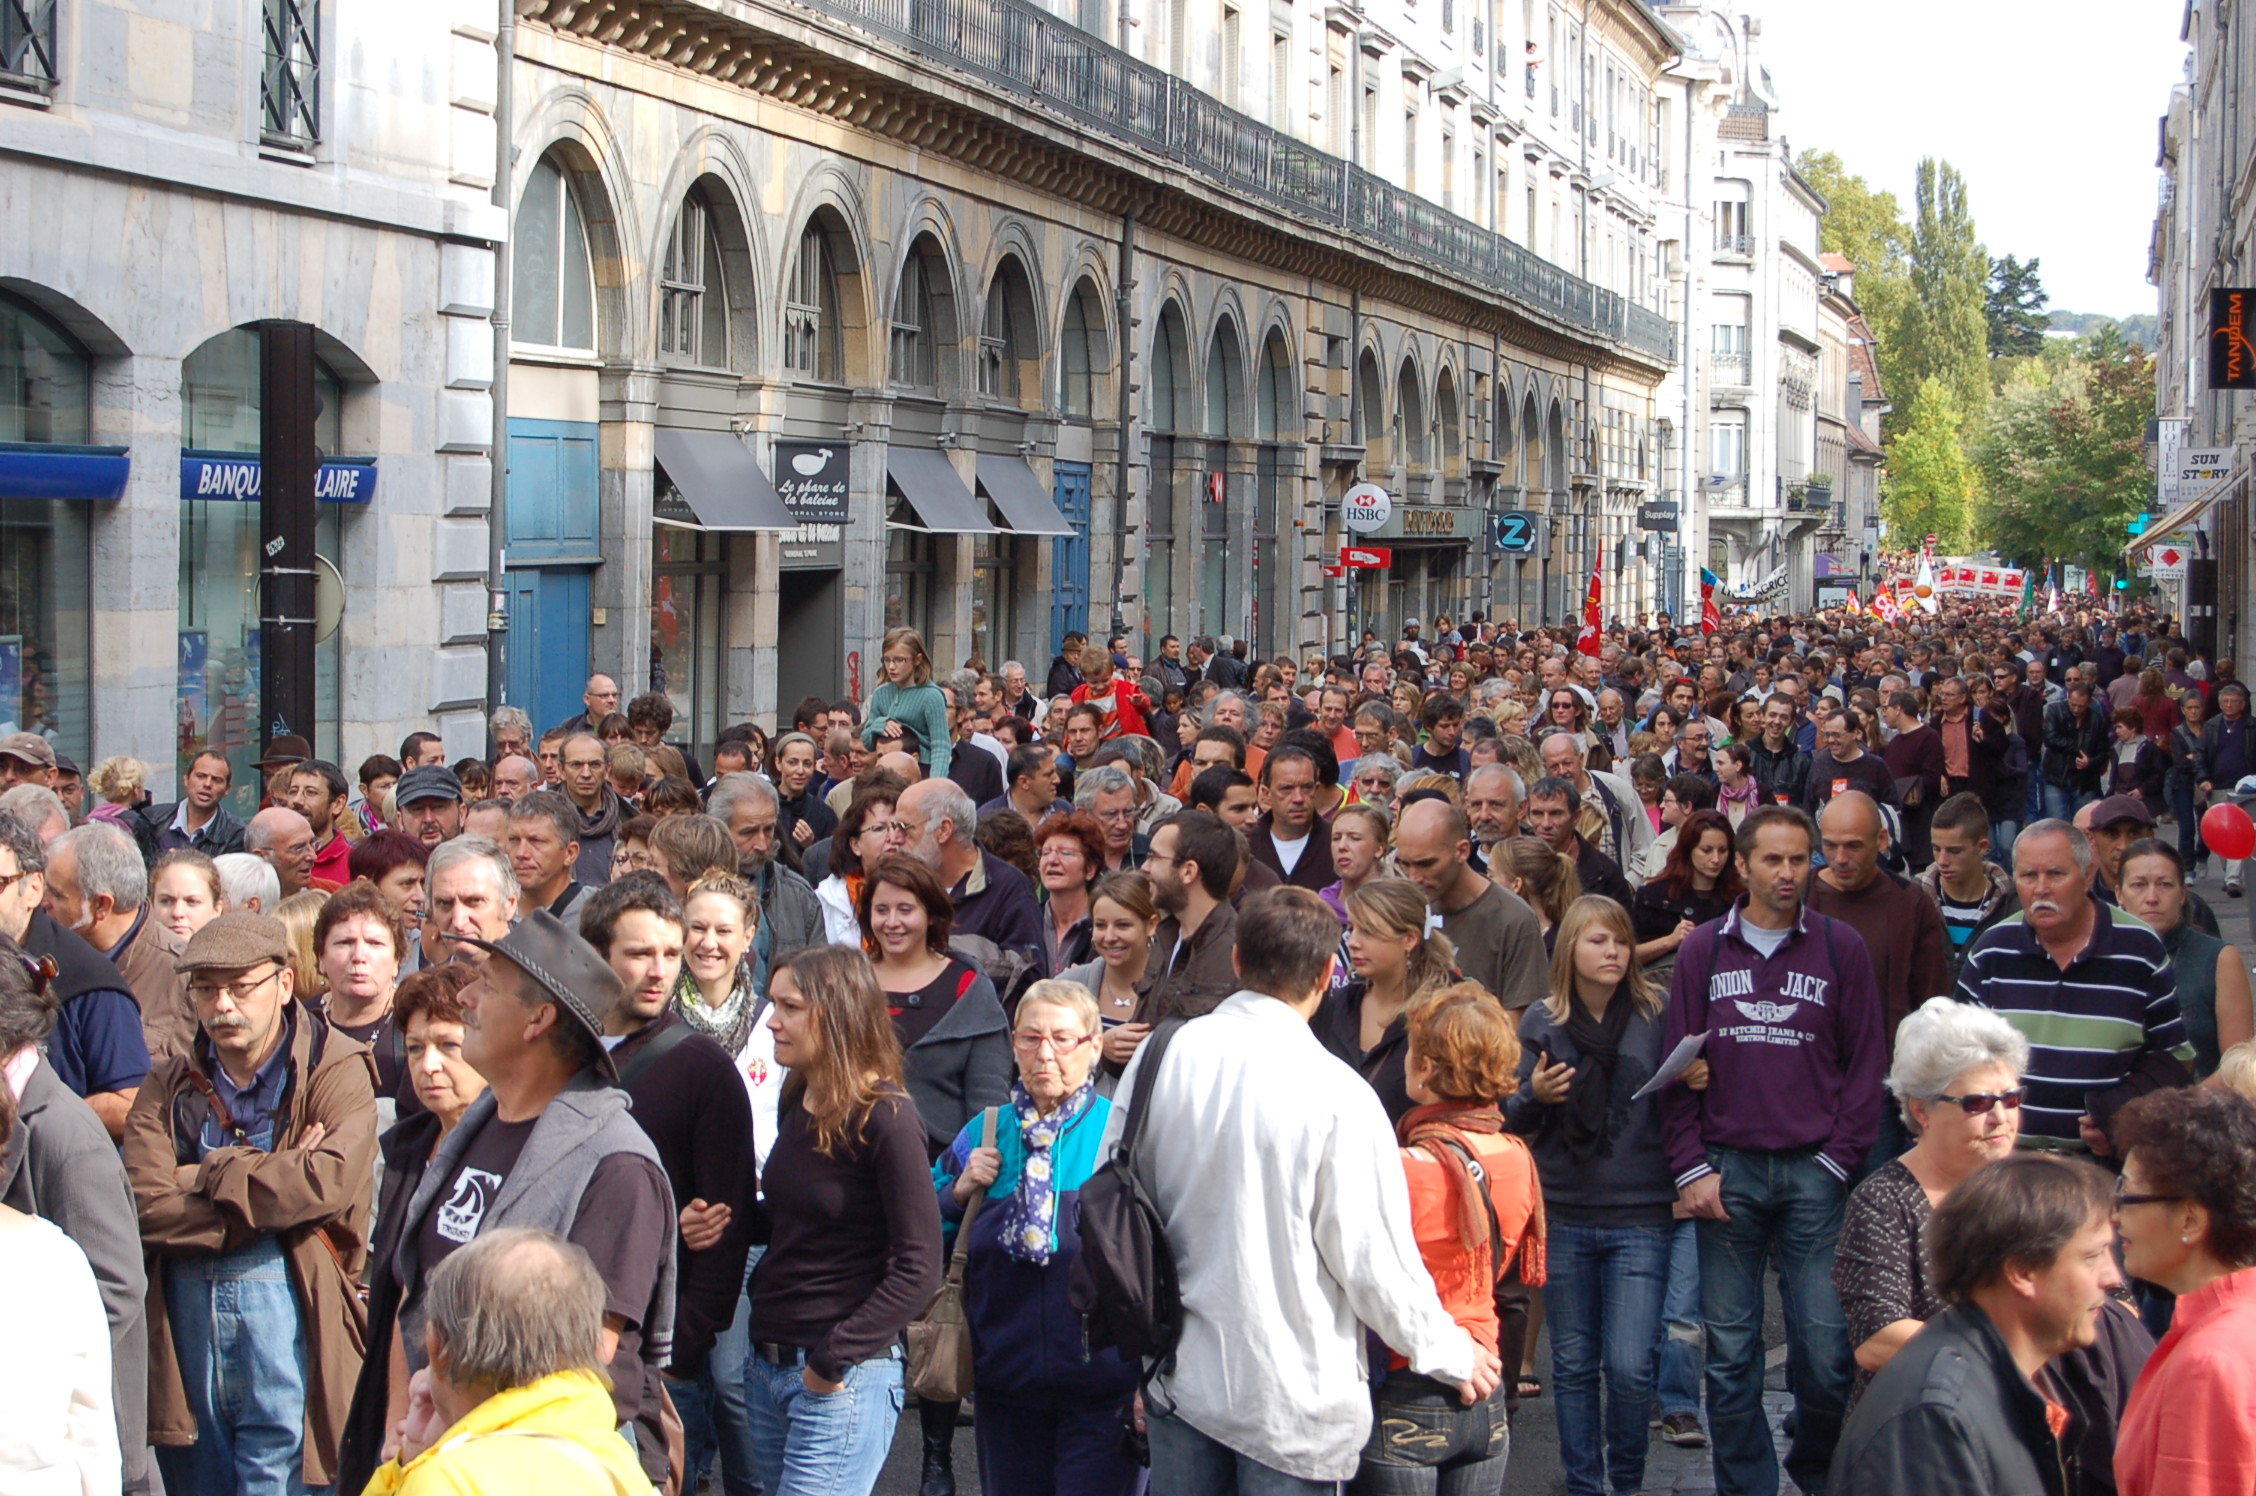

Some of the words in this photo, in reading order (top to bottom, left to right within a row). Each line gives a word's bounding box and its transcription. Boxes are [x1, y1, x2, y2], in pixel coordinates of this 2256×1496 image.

[2227, 293, 2243, 382] TANDEM
[2190, 454, 2220, 465] SUN
[197, 463, 261, 501] BANQU
[778, 479, 795, 494] Le
[796, 479, 830, 496] phare
[832, 480, 846, 493] de
[784, 492, 797, 505] la
[800, 492, 839, 506] baleine
[1346, 507, 1386, 521] HSBC
[1644, 510, 1676, 521] Supplay
[1501, 518, 1526, 545] Z
[1709, 969, 1754, 1001] UNION
[1779, 971, 1829, 1006] JACK
[1729, 1025, 1767, 1036] RITCHIE
[1768, 1026, 1796, 1038] JEANS
[1736, 1035, 1766, 1043] EDITION
[1767, 1035, 1800, 1046] LIMITED
